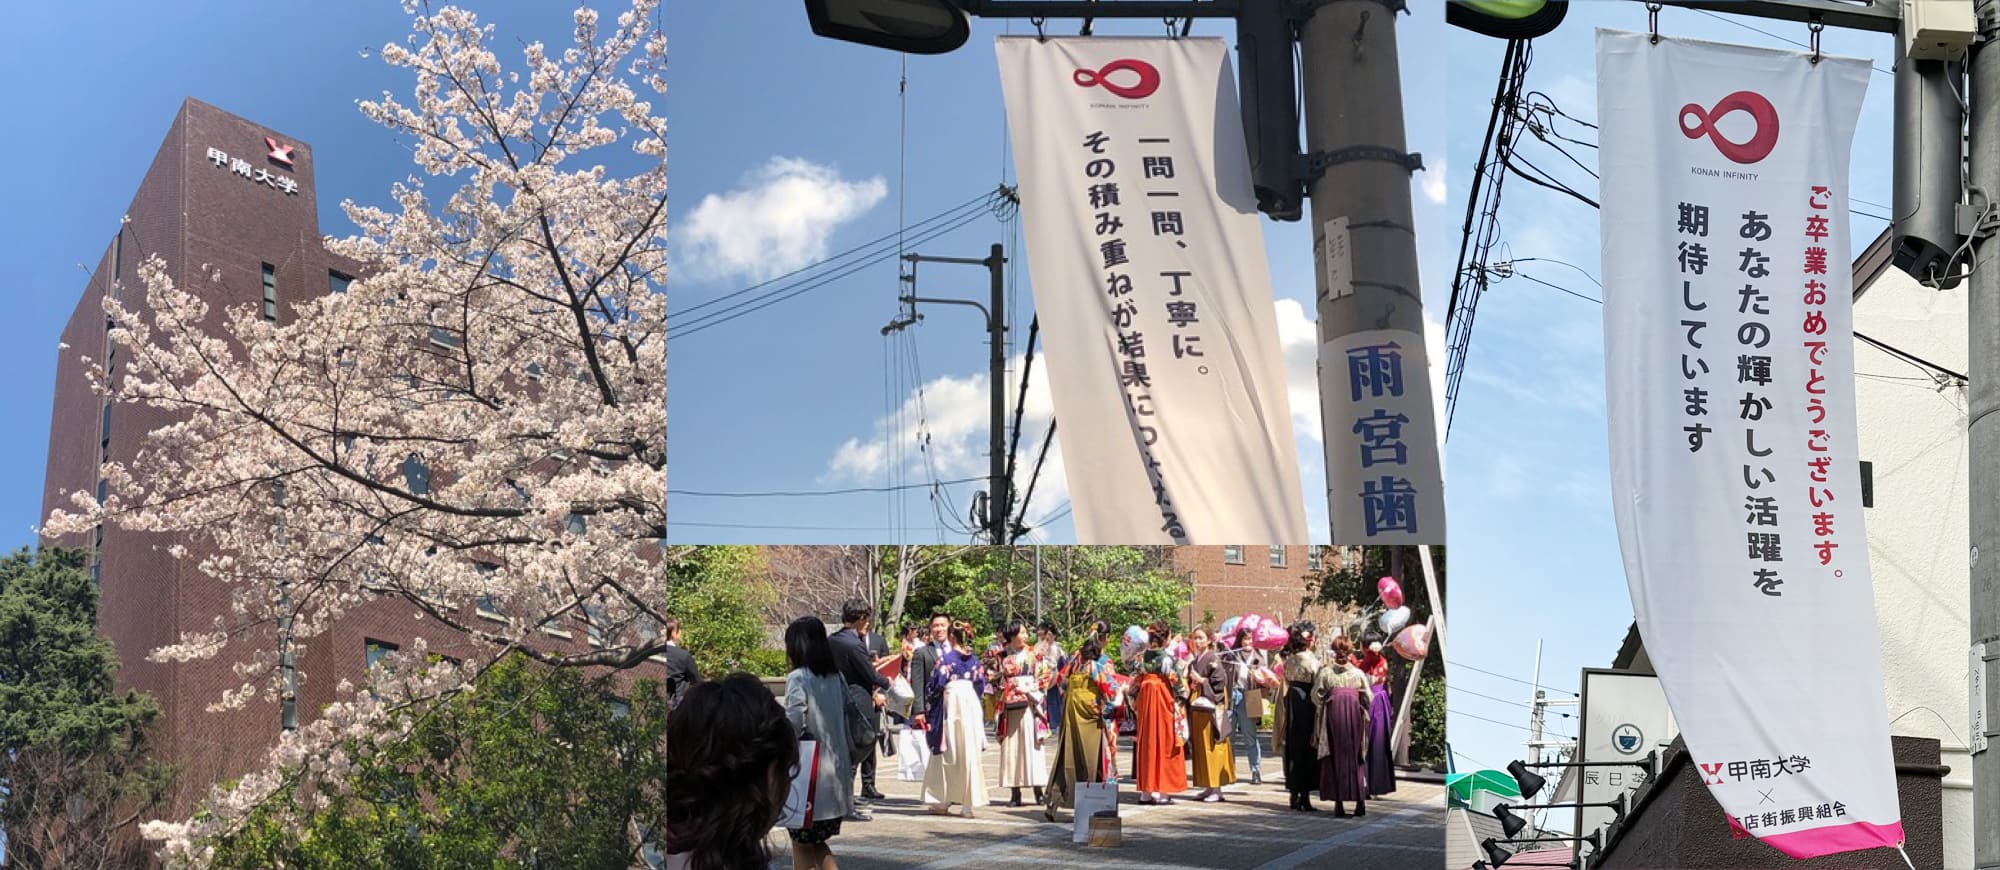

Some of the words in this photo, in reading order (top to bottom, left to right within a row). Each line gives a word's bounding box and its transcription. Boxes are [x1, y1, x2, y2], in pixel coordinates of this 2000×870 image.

[206, 146, 298, 194] 甲南大学
[1691, 166, 1720, 177] KONAN
[1723, 170, 1759, 182] INFINITY
[1677, 202, 1713, 453] 期待しています
[1736, 210, 1784, 597] あなたの輝かしい活躍を
[1802, 185, 1843, 578] ご卒業おめでとうございます。
[1345, 341, 1418, 537] 雨宮歯
[1728, 754, 1812, 782] 甲南大学
